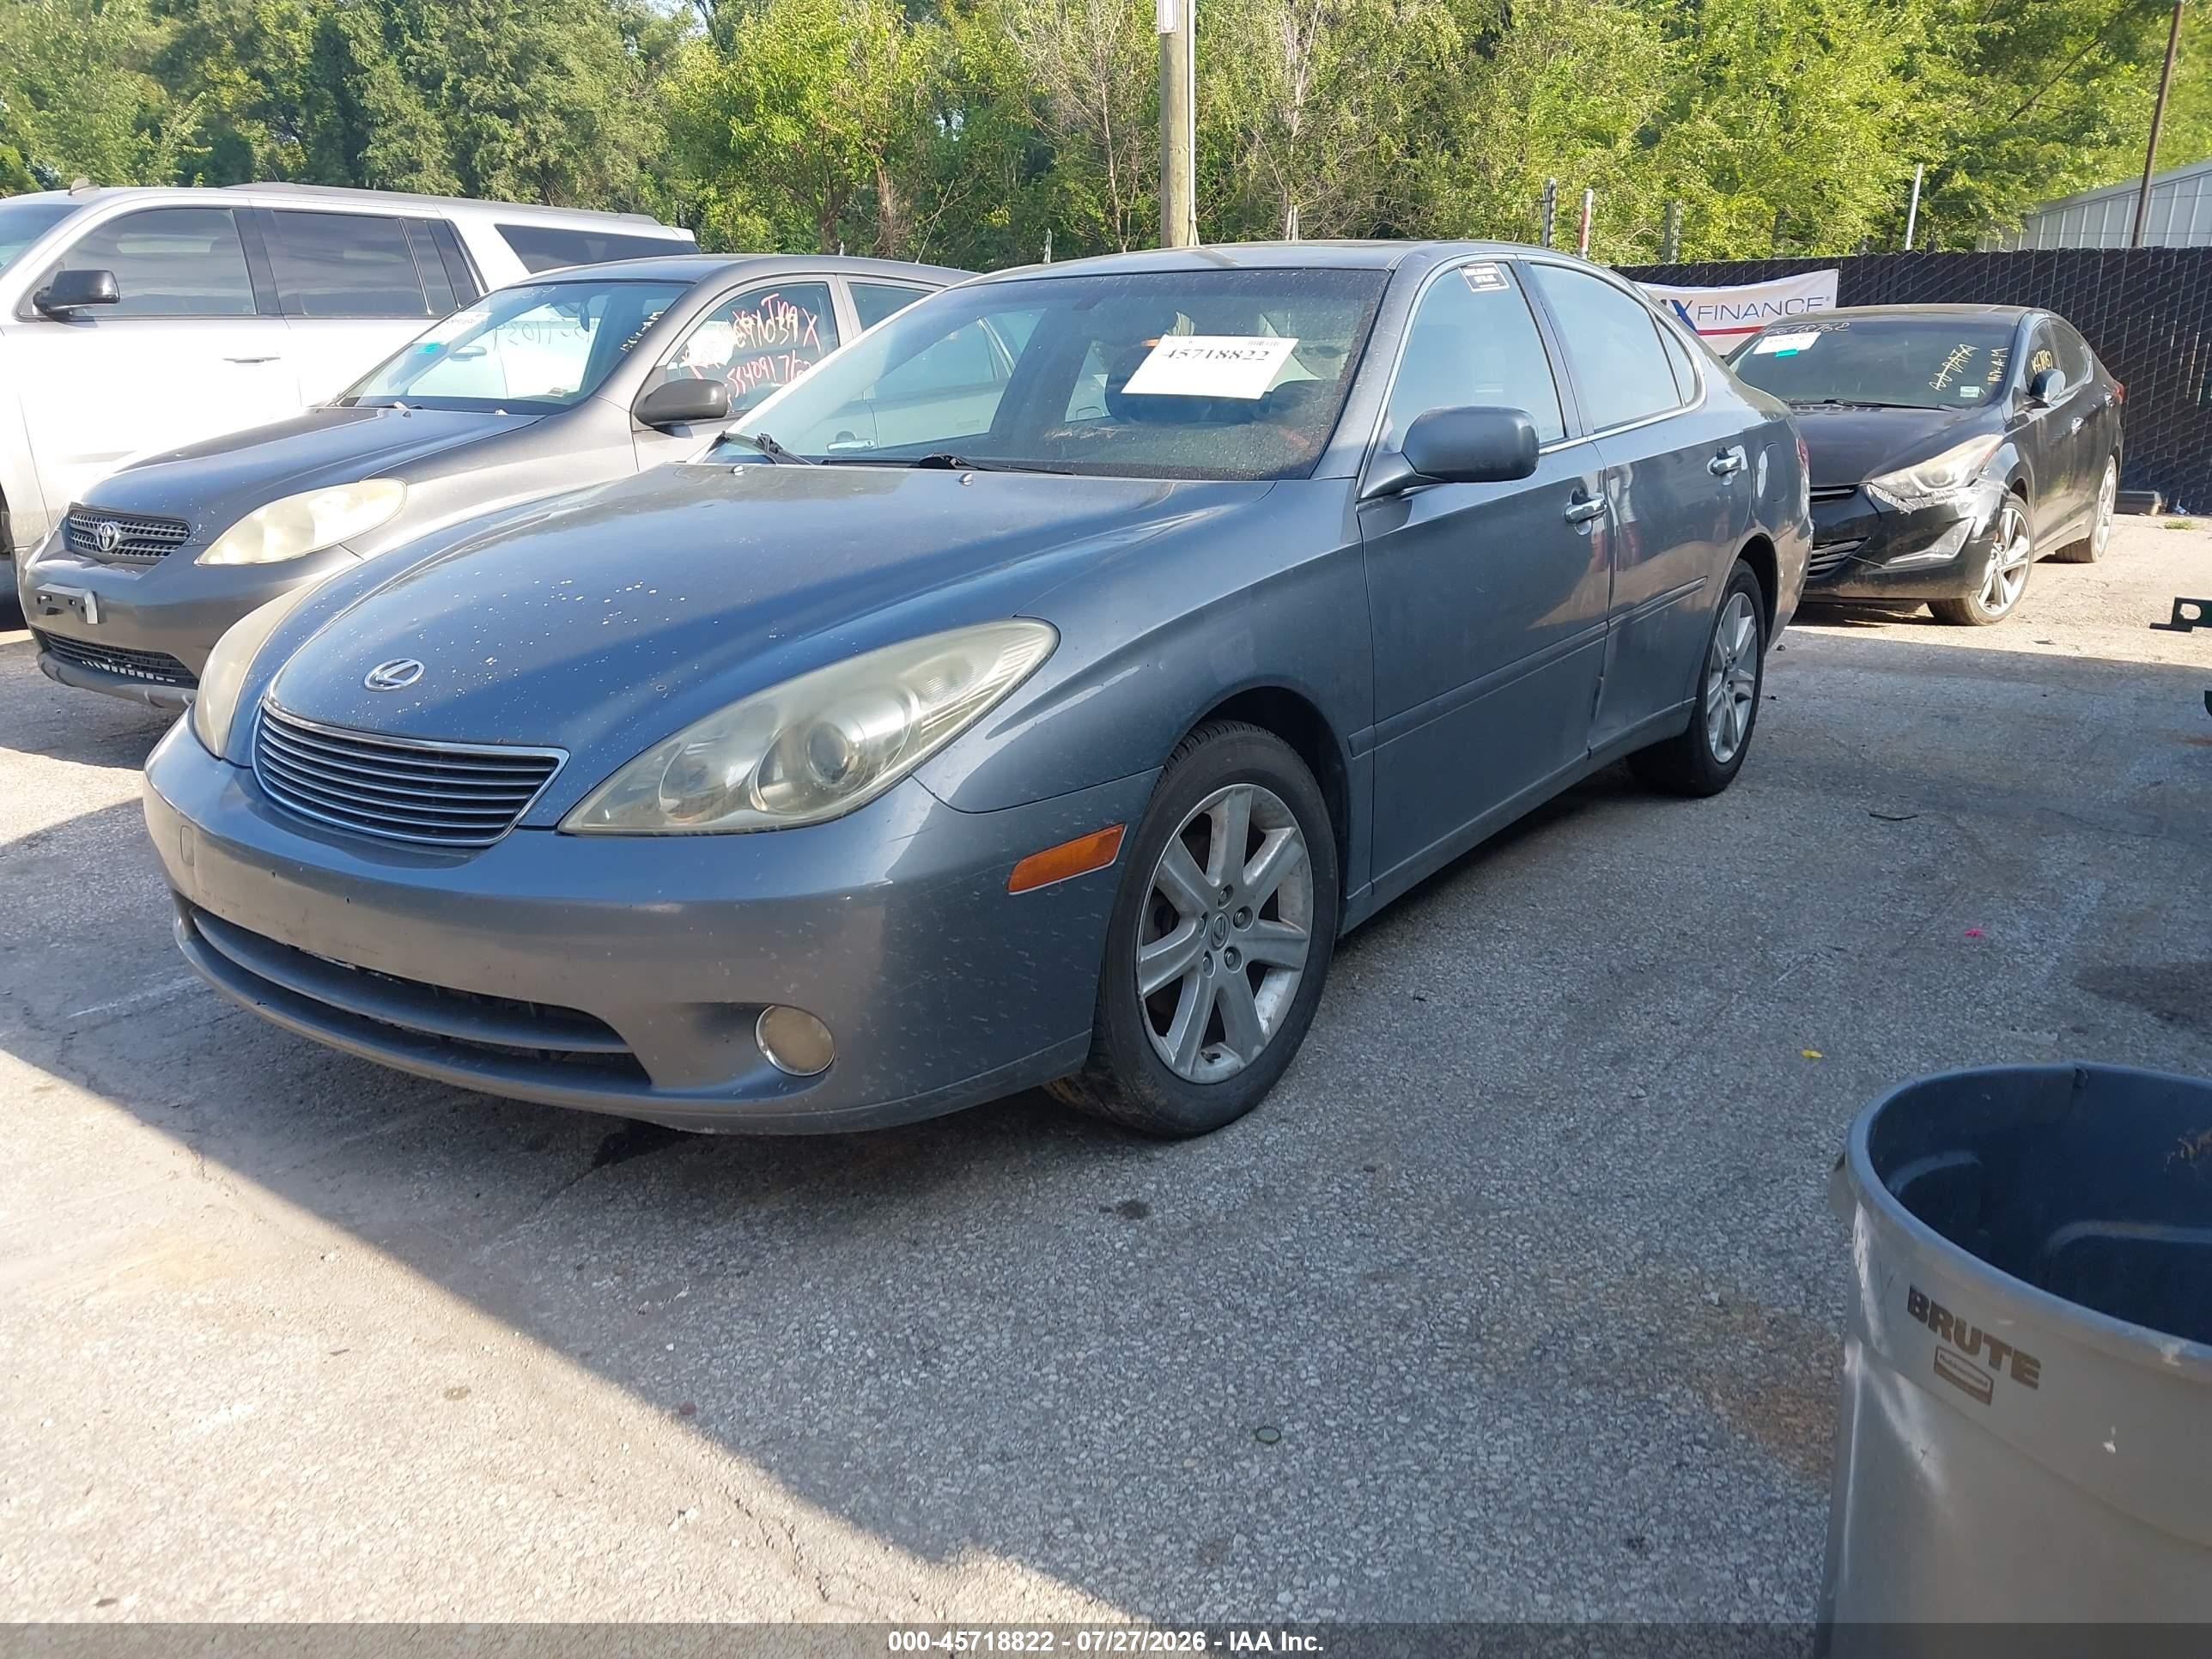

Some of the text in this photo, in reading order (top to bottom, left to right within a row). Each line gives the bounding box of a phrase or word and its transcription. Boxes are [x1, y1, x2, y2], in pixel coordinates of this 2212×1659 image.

[1697, 296, 1824, 321] FINANCE
[1162, 349, 1270, 361] 45718822
[1907, 1284, 2041, 1390] BRUTE
